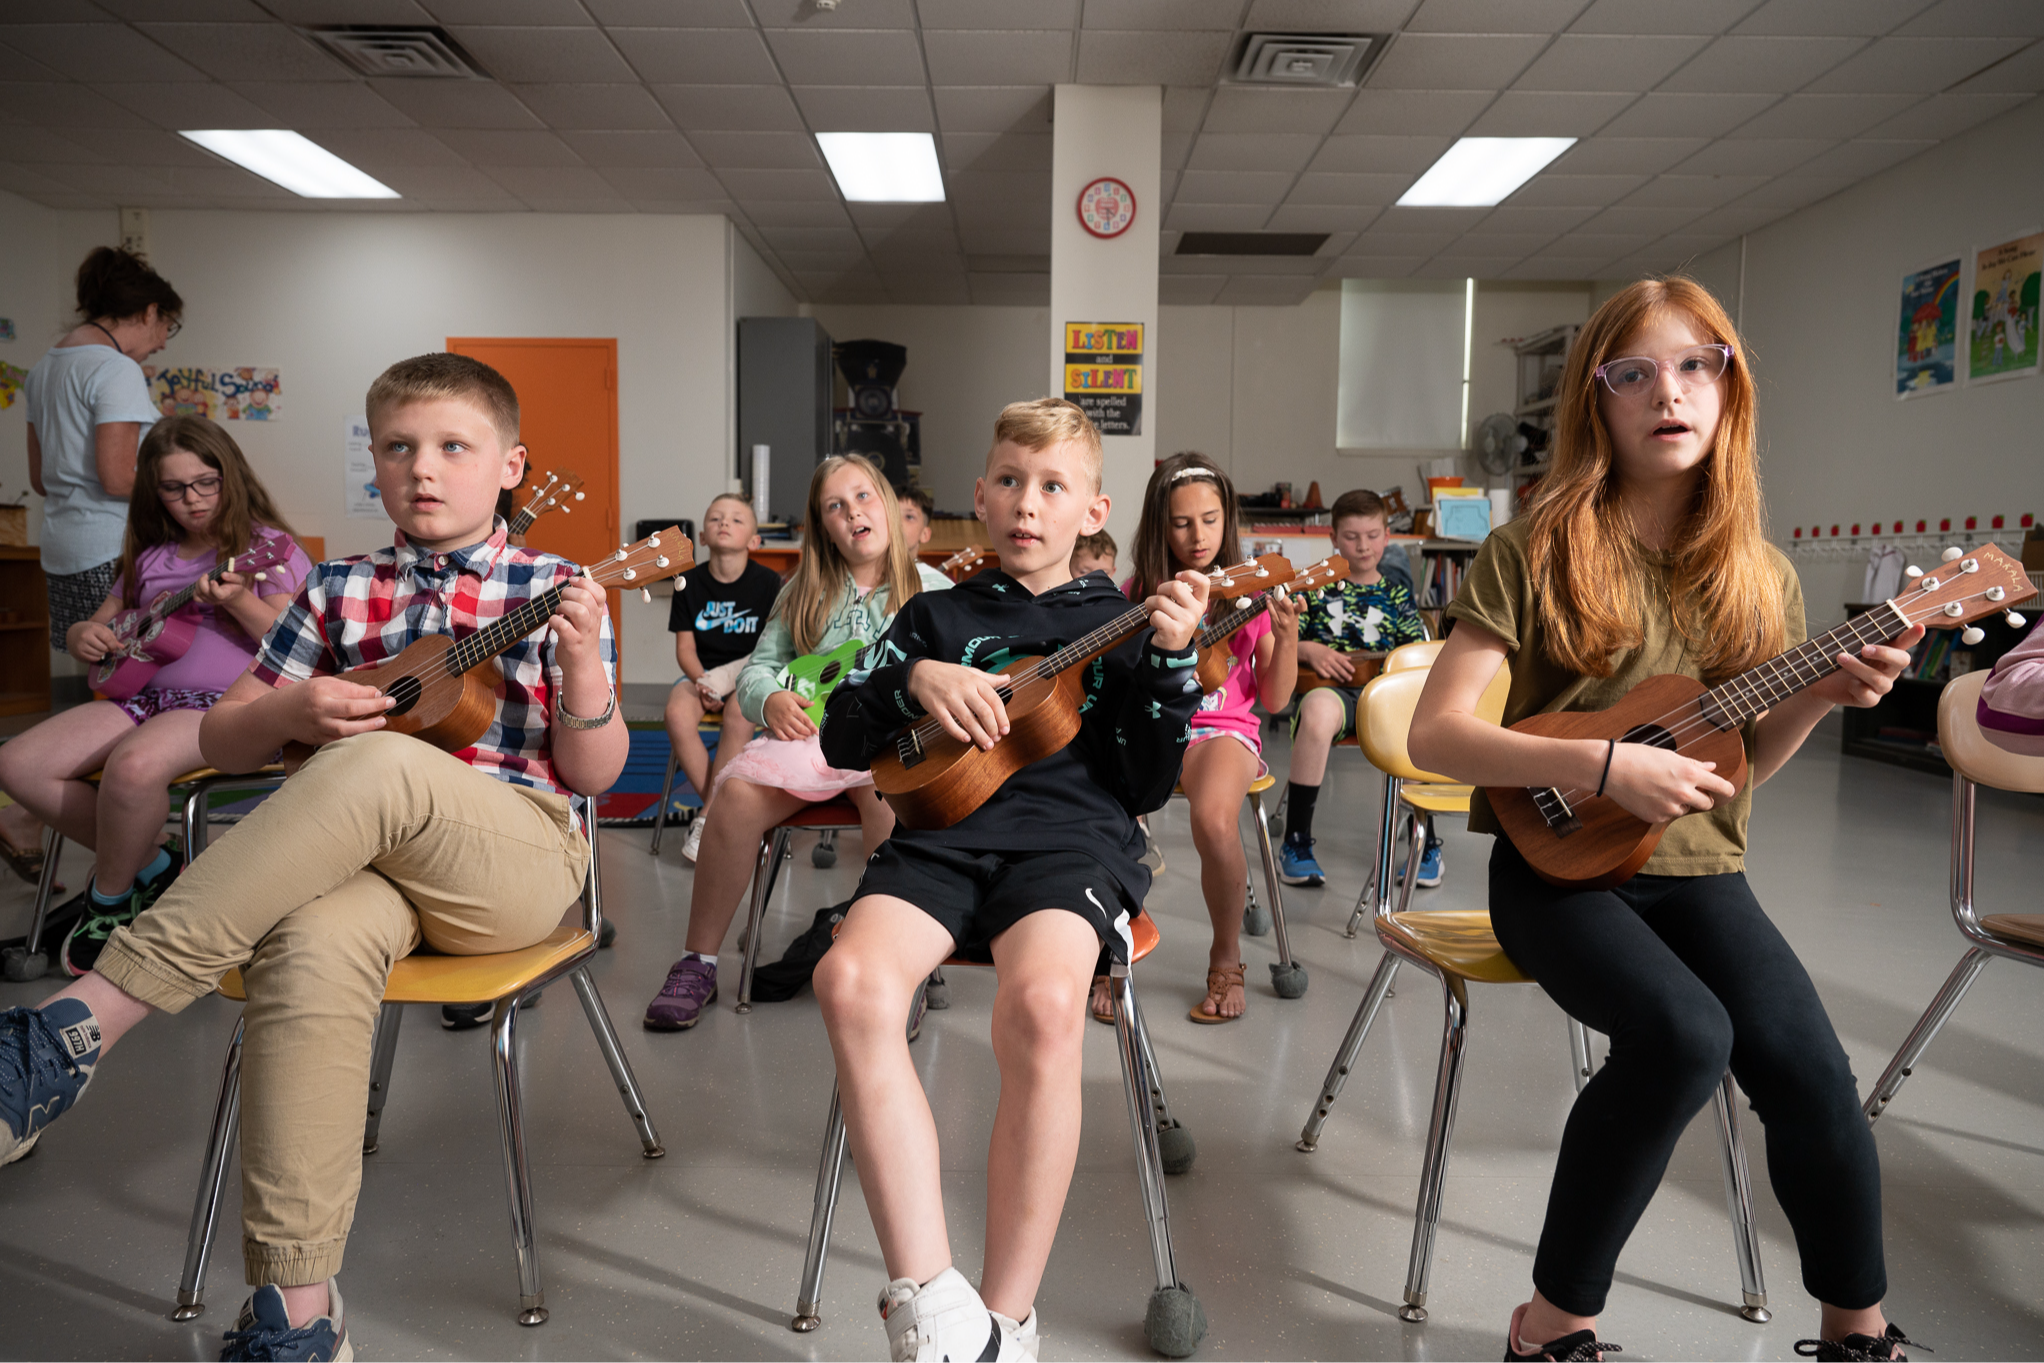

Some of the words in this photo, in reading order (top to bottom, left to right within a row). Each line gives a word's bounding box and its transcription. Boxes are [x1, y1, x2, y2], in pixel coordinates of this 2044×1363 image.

[1072, 329, 1138, 350] LISTEN
[1096, 354, 1113, 364] and
[1071, 368, 1137, 389] SILENT
[1080, 398, 1095, 406] are
[1096, 396, 1127, 407] spelled
[1086, 408, 1105, 418] with
[1106, 408, 1121, 418] the
[1983, 552, 2024, 592] MAKALA
[703, 601, 736, 618] JUST
